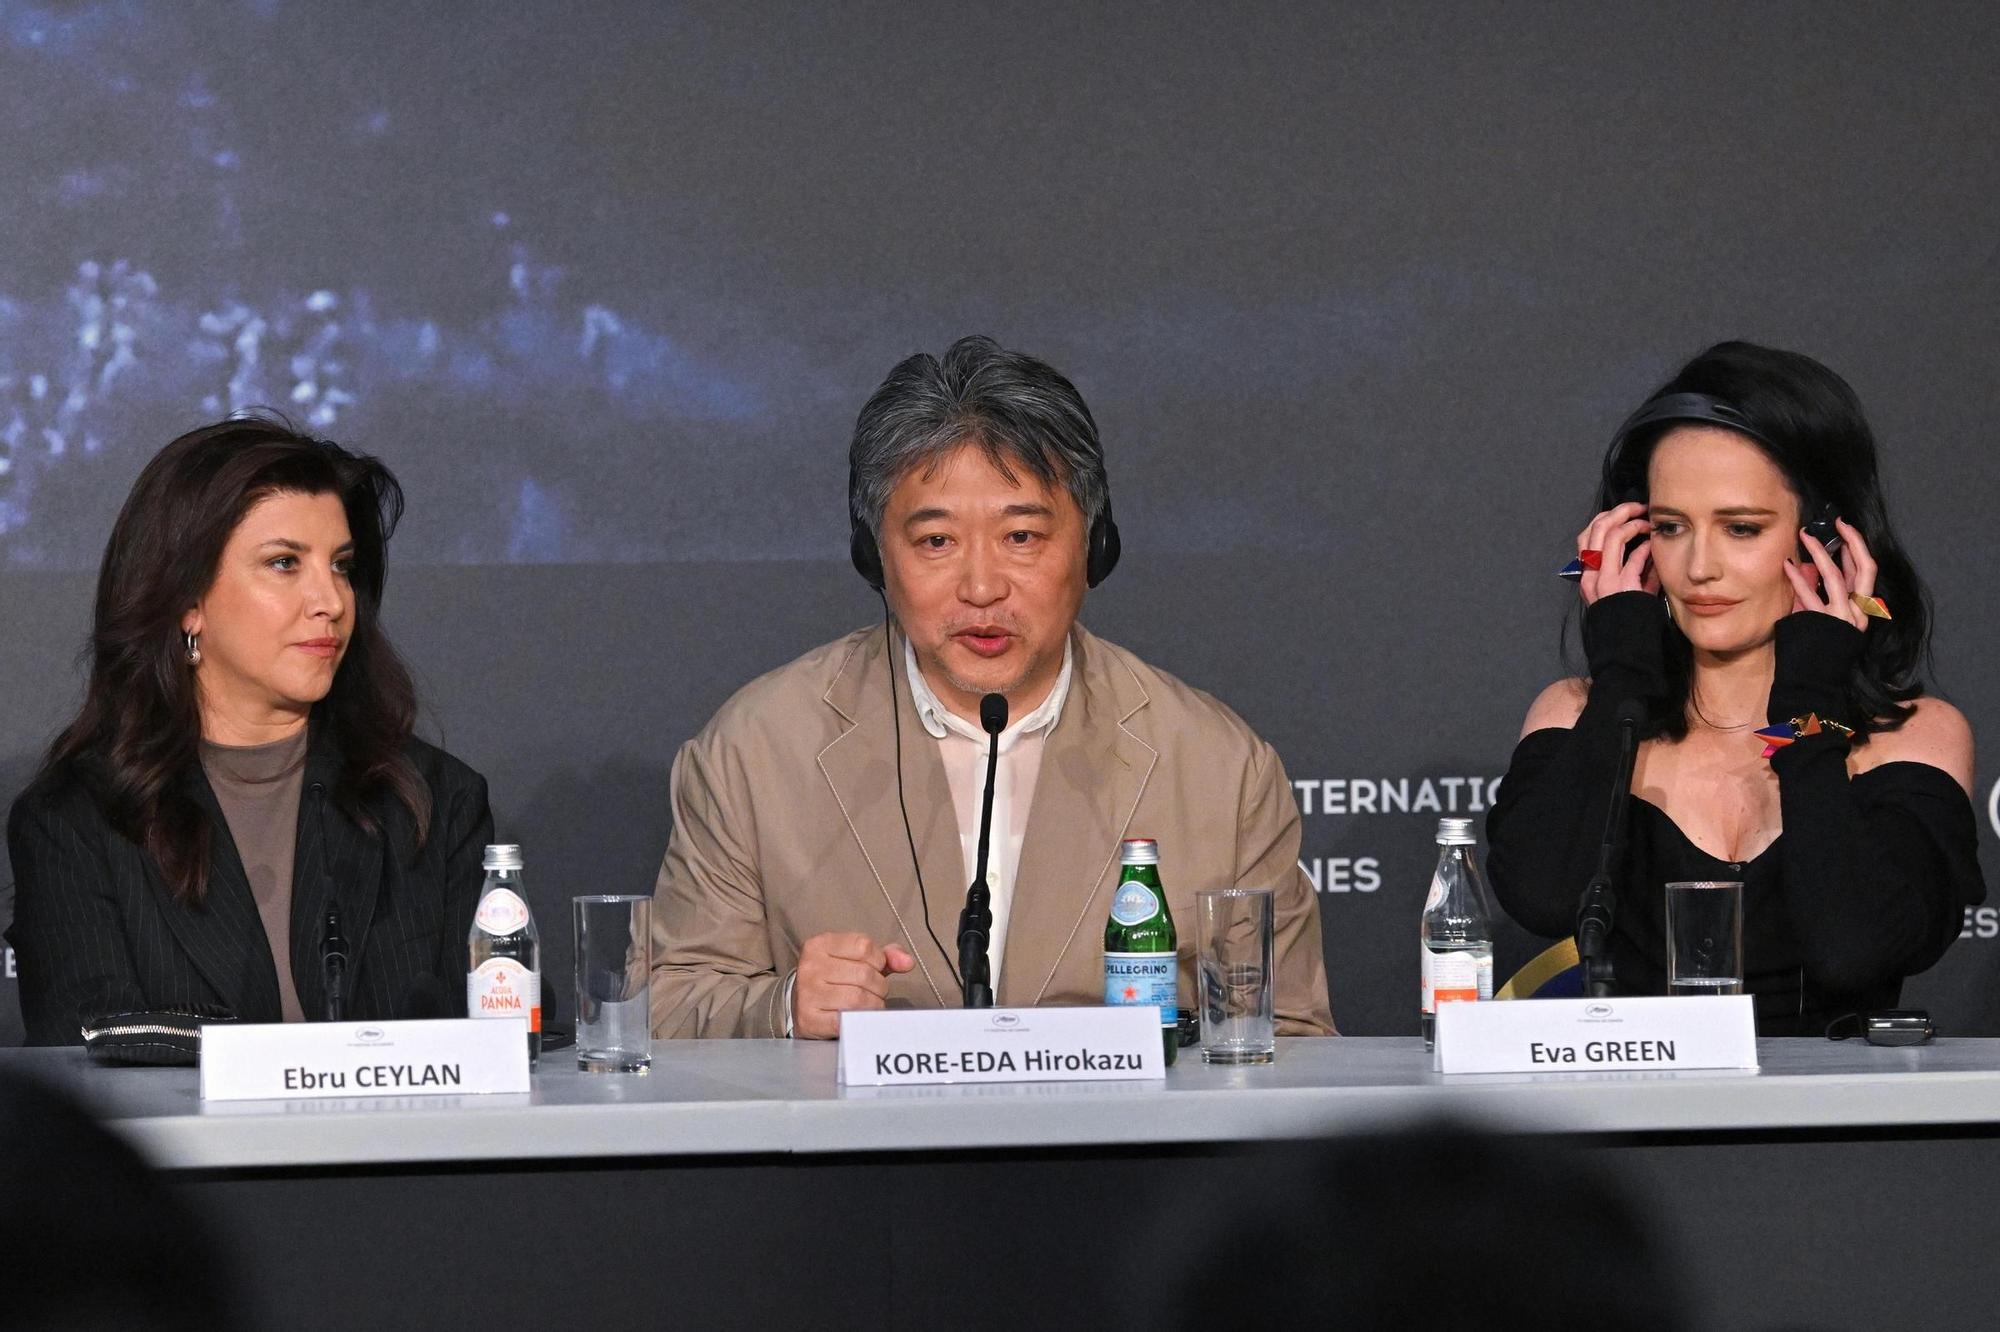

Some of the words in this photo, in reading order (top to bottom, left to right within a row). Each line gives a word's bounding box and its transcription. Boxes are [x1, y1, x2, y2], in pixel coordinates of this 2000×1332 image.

[1288, 776, 1504, 815] TERNATI
[481, 995, 522, 1010] PANNA
[875, 1051, 1016, 1076] KORE-EDA
[1025, 1048, 1143, 1072] Hirokazu
[1530, 1042, 1577, 1064] Eva
[1585, 1040, 1676, 1063] GREEN
[284, 1066, 346, 1090] Ebru
[355, 1064, 462, 1088] CEYLAN
